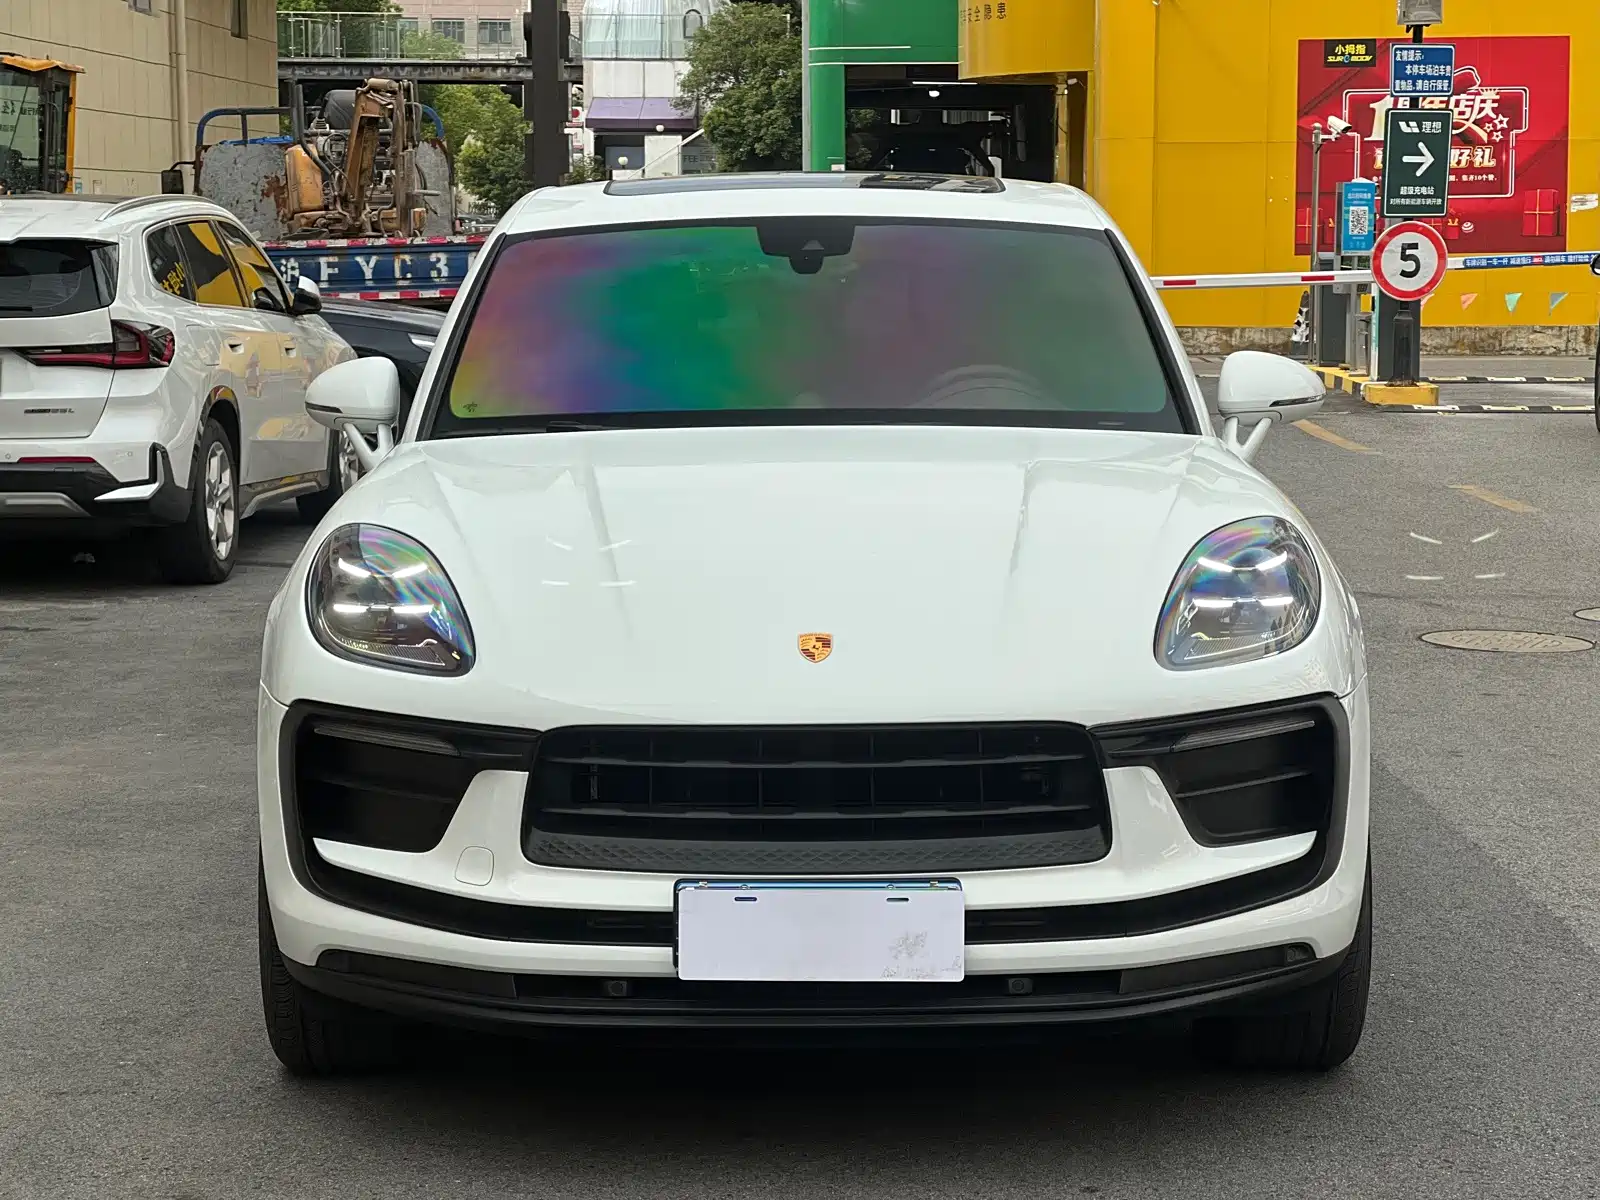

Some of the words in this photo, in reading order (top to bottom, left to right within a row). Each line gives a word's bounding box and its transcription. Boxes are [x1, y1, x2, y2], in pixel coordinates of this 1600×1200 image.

[1334, 44, 1366, 55] 小拇指
[1405, 64, 1452, 77] 本停车场泊车贵
[1421, 121, 1442, 134] 理想
[1400, 186, 1435, 195] 超级充电站
[1399, 242, 1421, 278] 5
